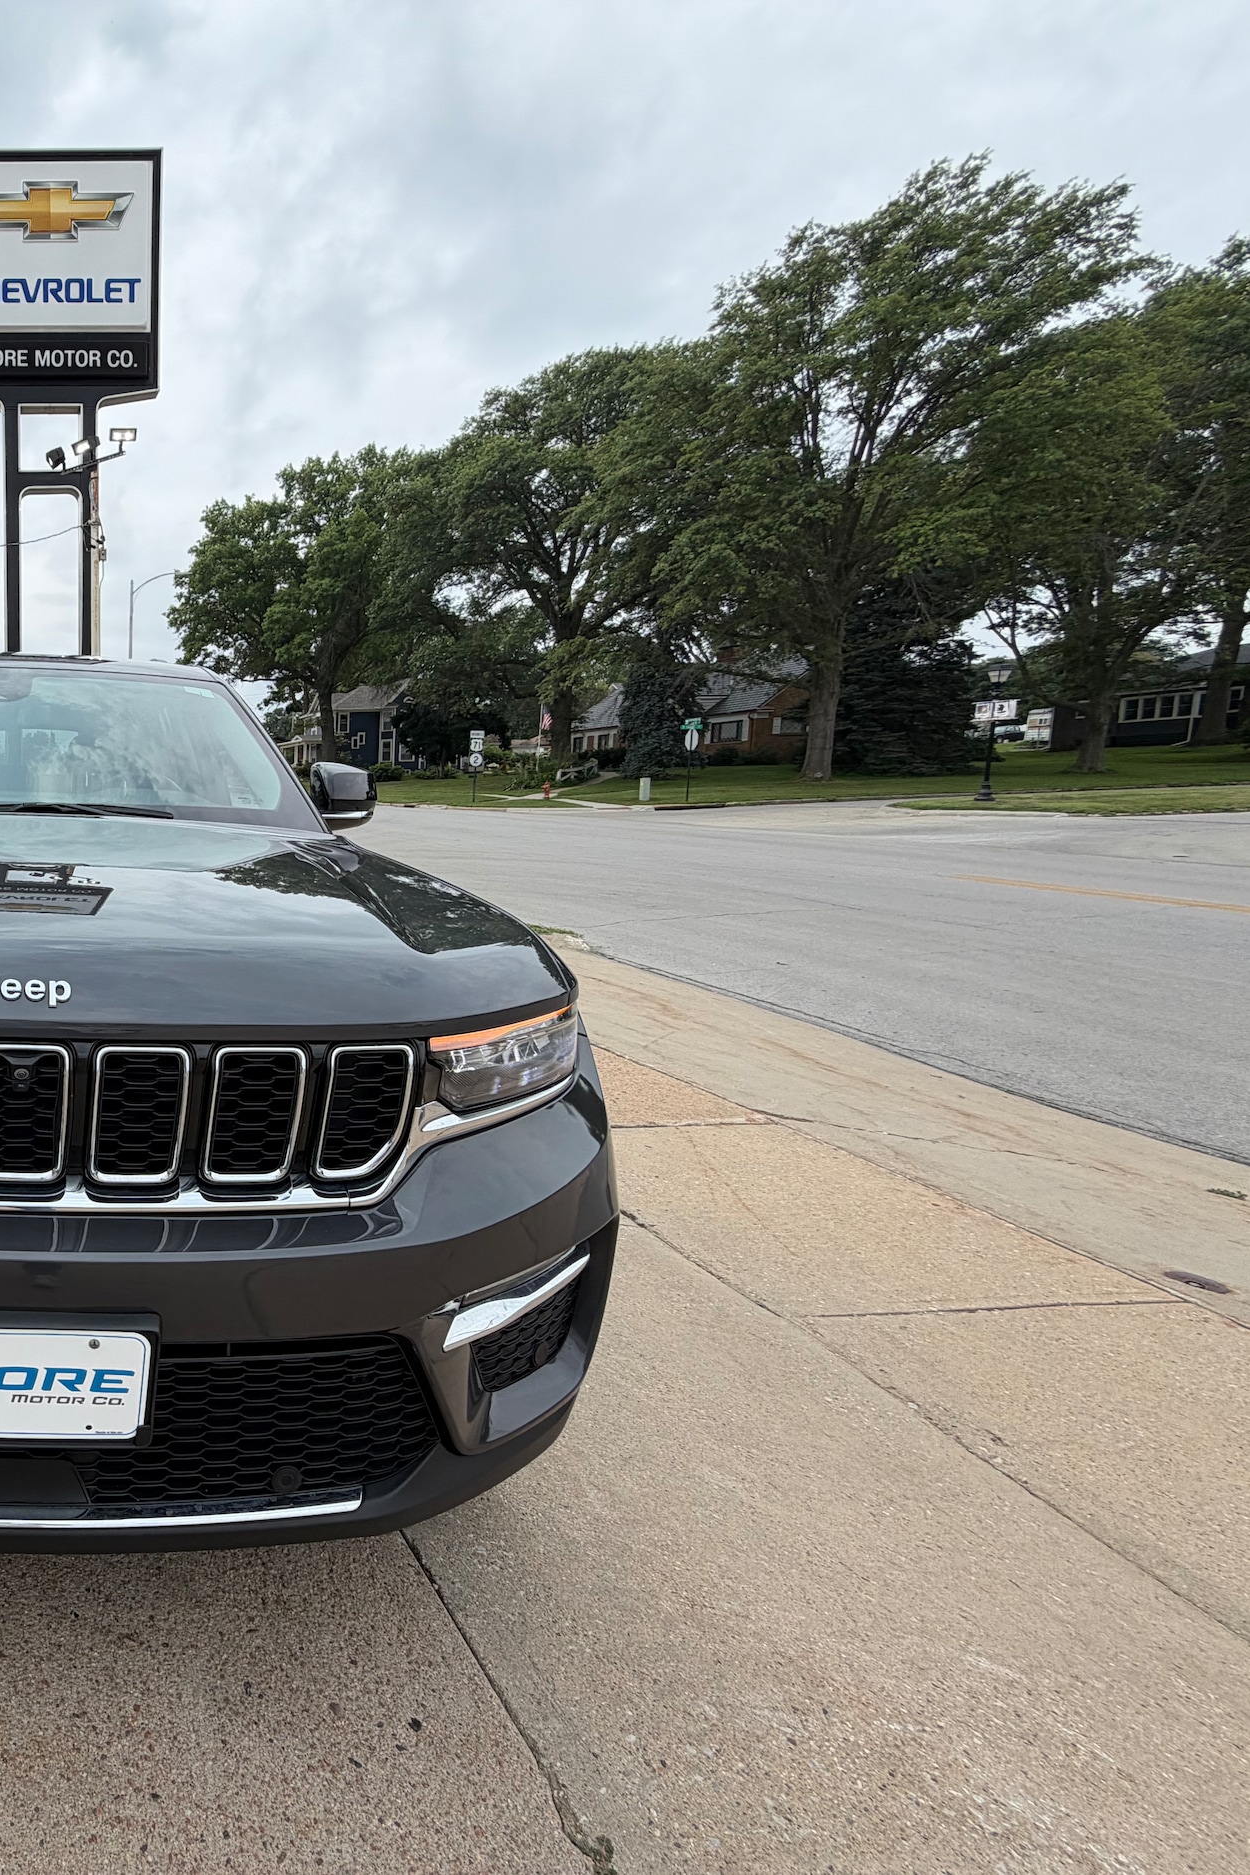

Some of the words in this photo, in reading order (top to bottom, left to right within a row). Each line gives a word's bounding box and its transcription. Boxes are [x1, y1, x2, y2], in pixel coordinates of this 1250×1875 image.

[34, 349, 101, 368] MOTOR
[106, 349, 138, 368] CO.
[473, 740, 481, 750] 71
[473, 755, 479, 764] 2
[11, 1394, 86, 1405] MOTOR
